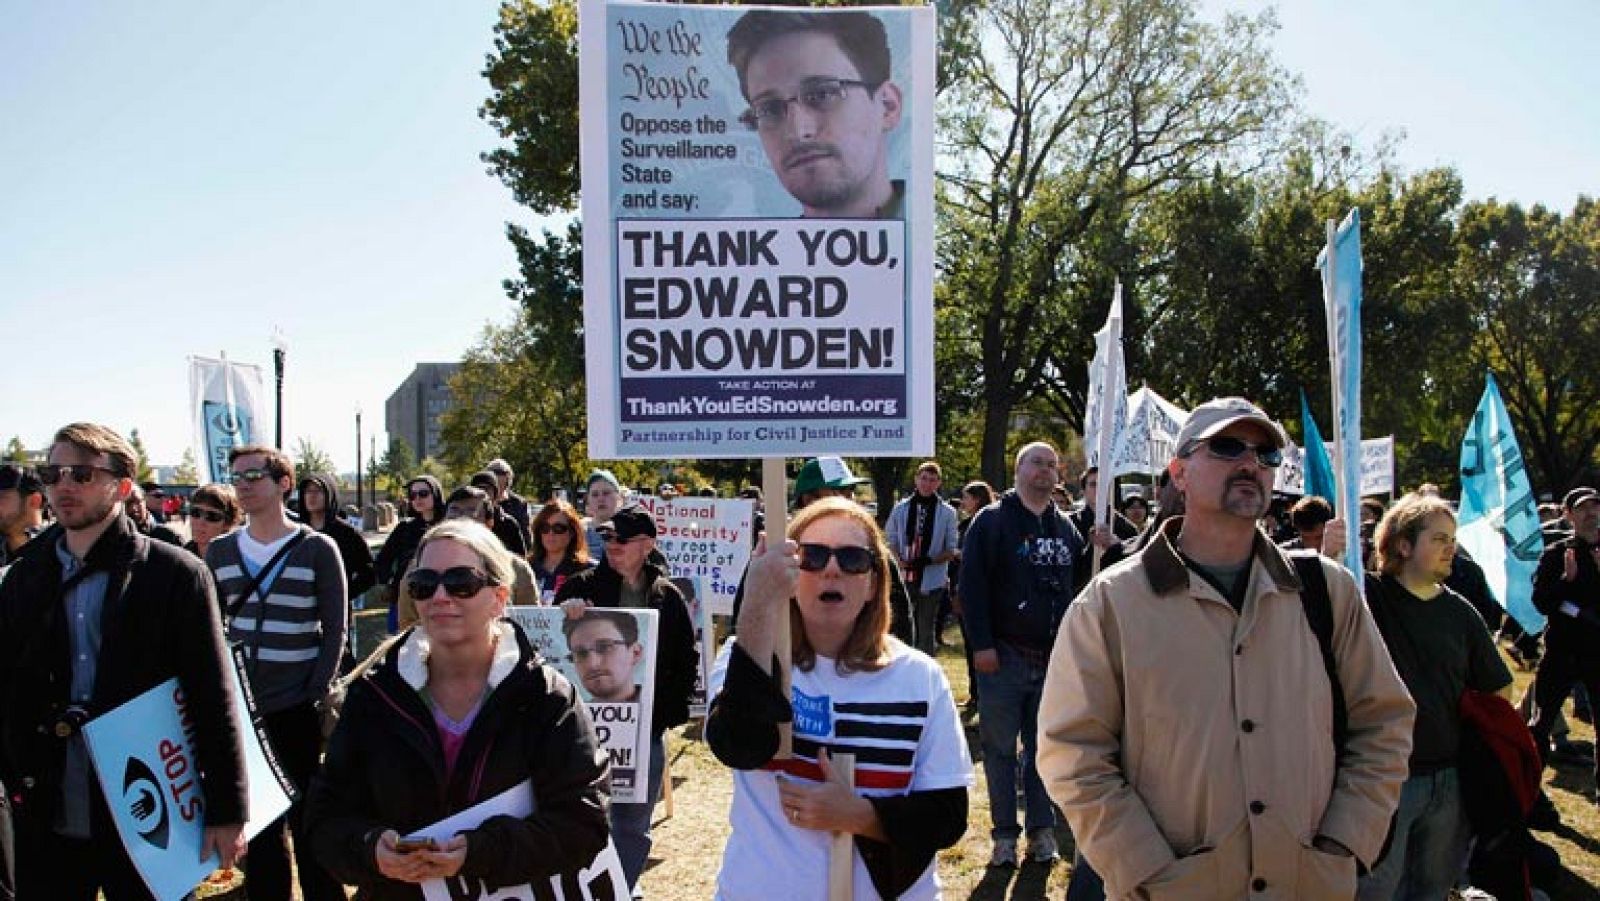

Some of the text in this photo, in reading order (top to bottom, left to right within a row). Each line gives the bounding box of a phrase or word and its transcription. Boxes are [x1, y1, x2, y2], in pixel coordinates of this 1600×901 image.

[618, 19, 701, 56] We the
[622, 64, 709, 108] People
[621, 112, 726, 135] Oppose the
[621, 139, 736, 159] Surveillance
[622, 164, 672, 184] State
[622, 189, 699, 211] and say:
[622, 229, 898, 269] THANK YOU,
[624, 275, 848, 319] EDWARD
[626, 327, 894, 371] SNOWDEN!
[718, 380, 816, 390] TAKE ACTION AT
[627, 396, 897, 417] ThankYouEdSnowden.org
[621, 425, 904, 445] Partnership for Civil Justice Fund
[716, 554, 734, 565] of
[590, 706, 635, 724] YOU,
[158, 739, 201, 822] STOP
